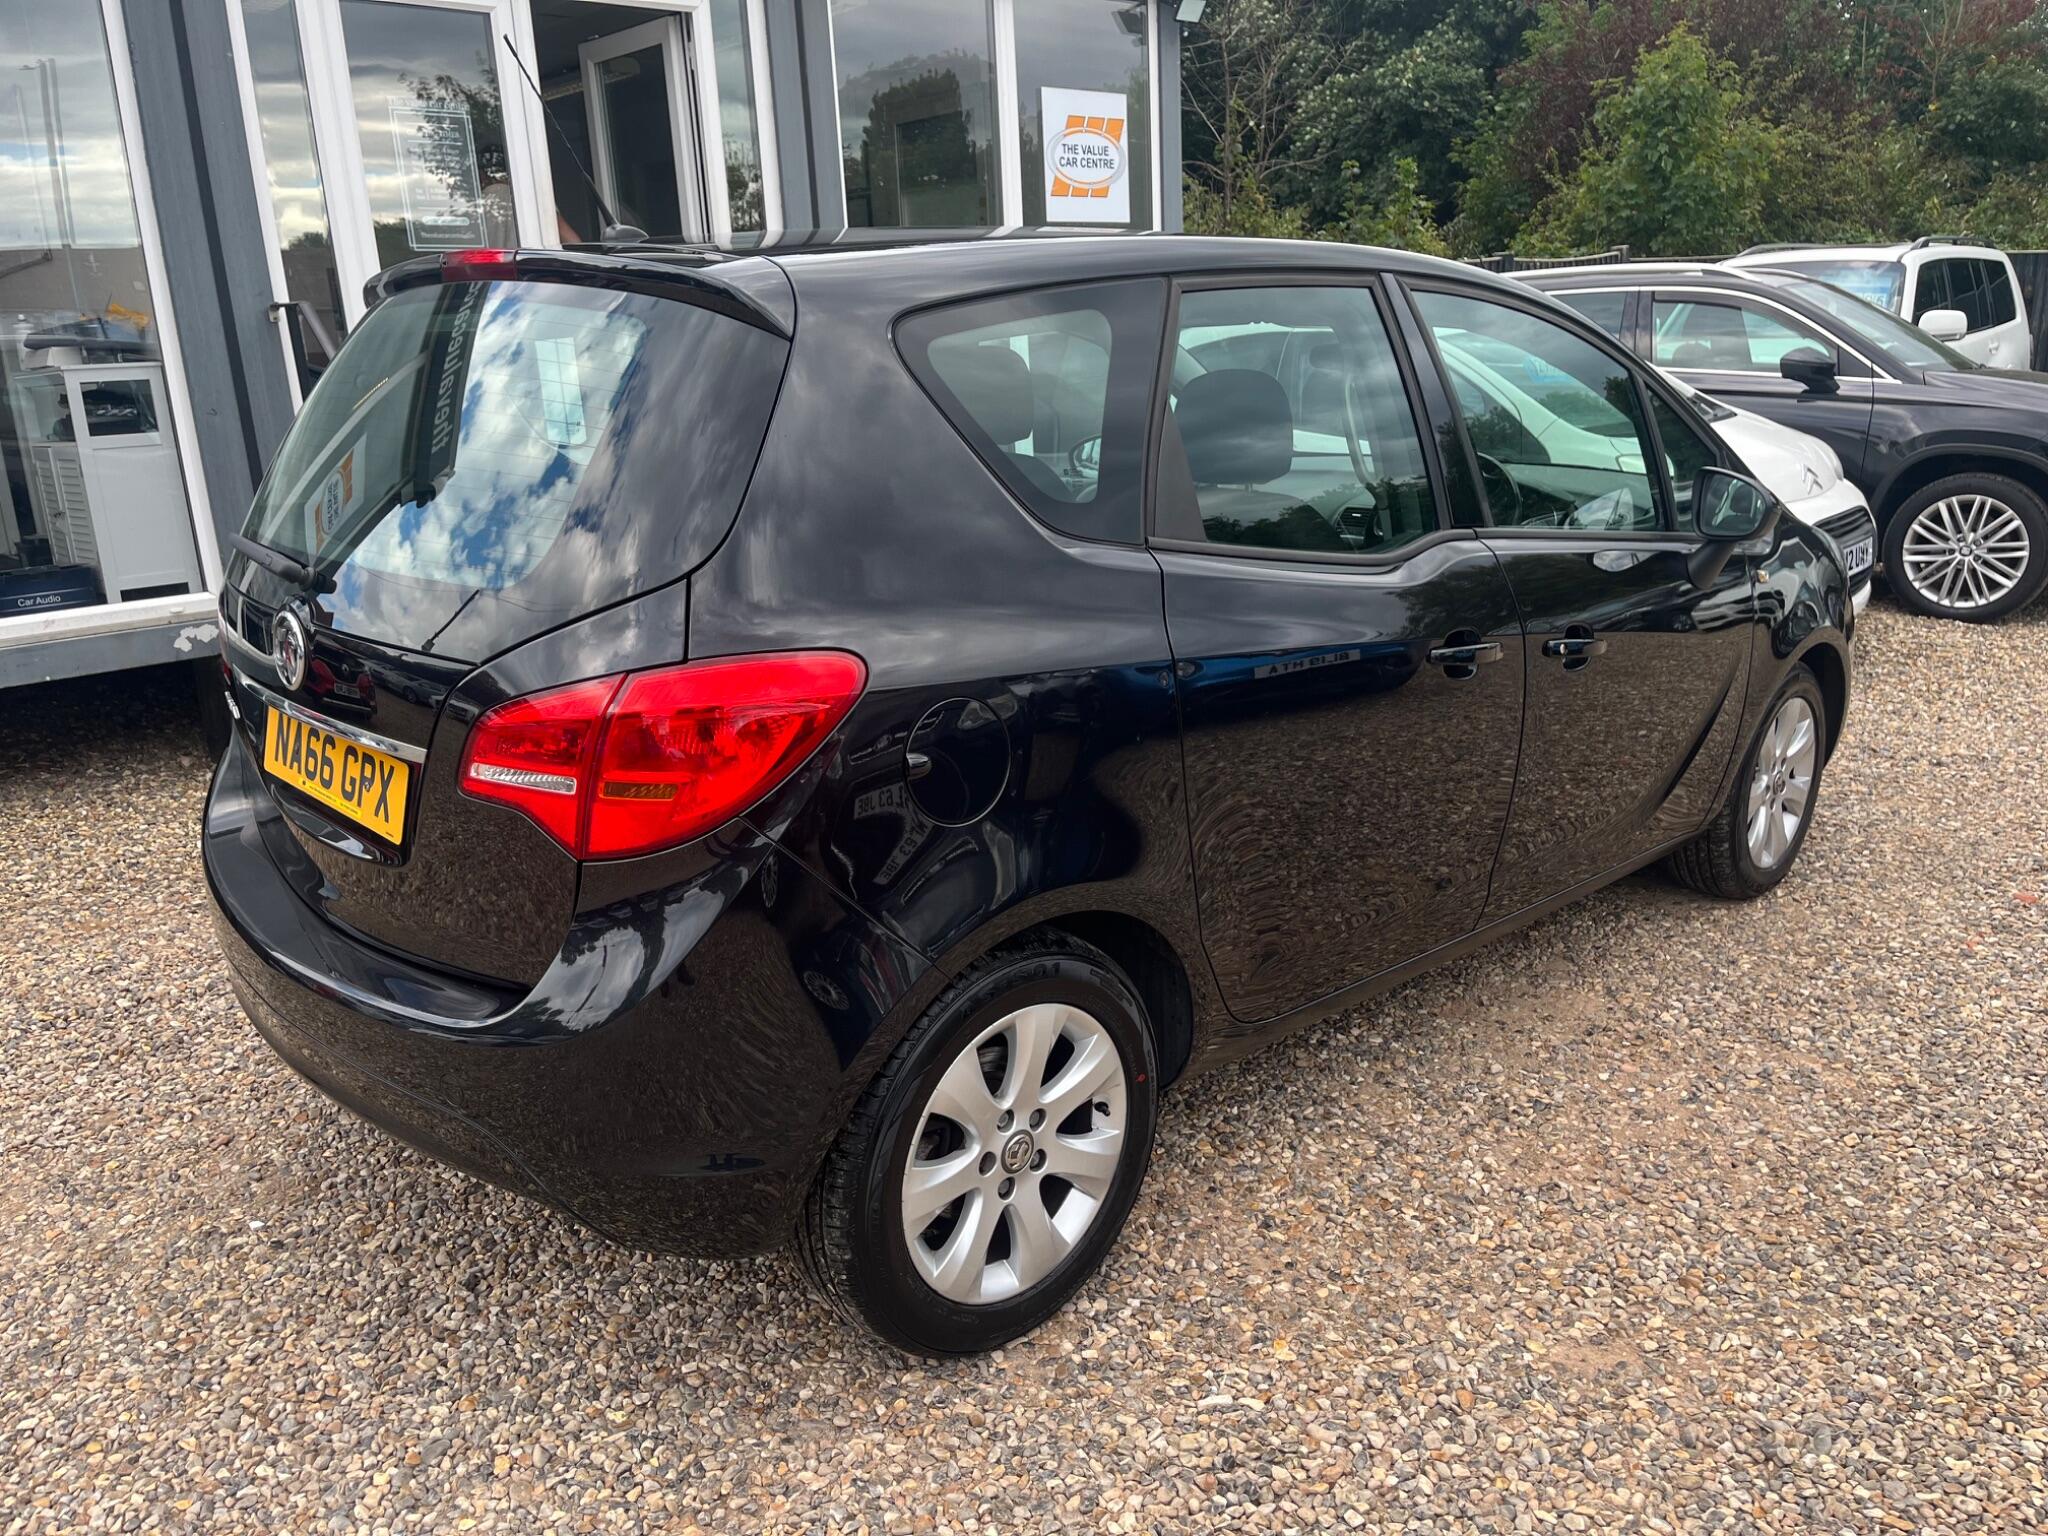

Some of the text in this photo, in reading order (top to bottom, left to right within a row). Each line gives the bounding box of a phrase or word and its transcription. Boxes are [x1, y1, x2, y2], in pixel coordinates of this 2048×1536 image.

[1062, 143, 1109, 156] THE VALUE
[1059, 156, 1115, 169] CAR CENTRE
[17, 594, 61, 607] Car Audio
[275, 711, 395, 824] NA66 GPX
